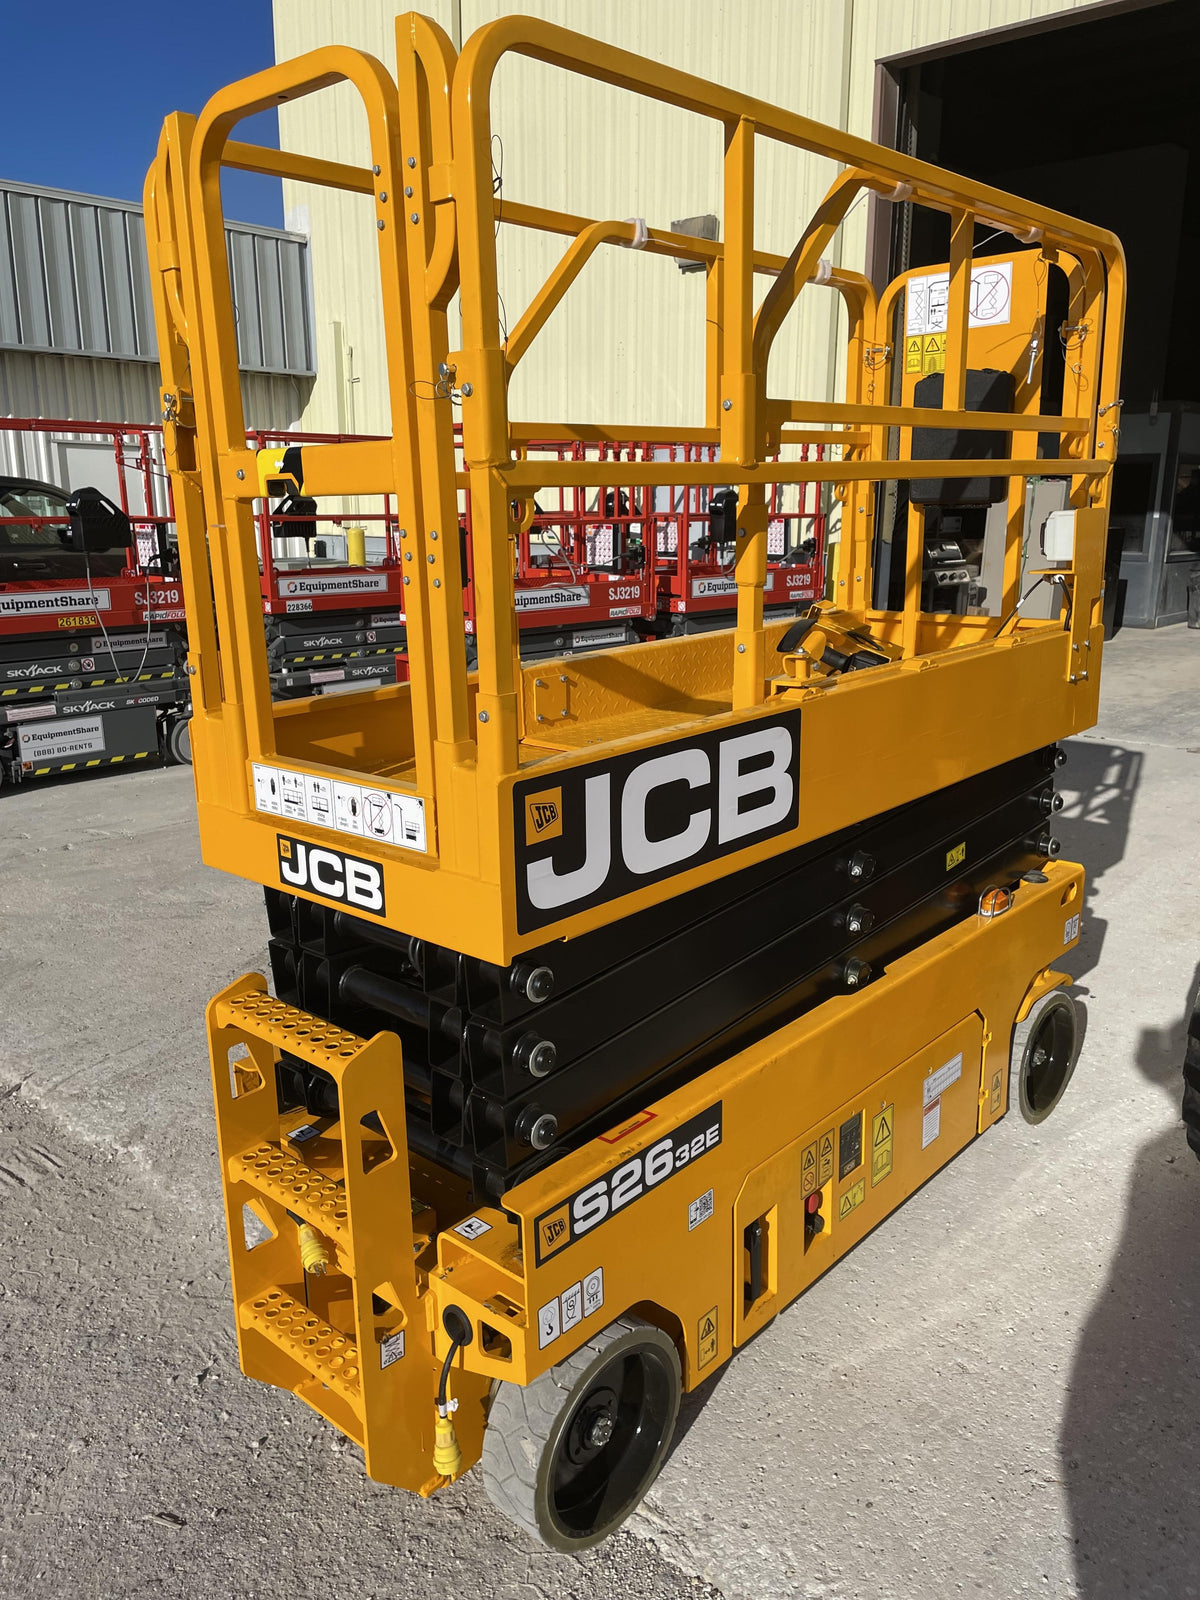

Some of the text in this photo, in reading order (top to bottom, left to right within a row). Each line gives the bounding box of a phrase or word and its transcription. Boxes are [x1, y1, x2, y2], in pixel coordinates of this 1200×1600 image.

[299, 579, 379, 592] EquipmentShare
[786, 574, 811, 587] SJ3219
[515, 592, 581, 607] uipmentShare
[609, 586, 640, 600] SJ3219
[0, 595, 99, 613] uipmentShare
[287, 601, 312, 612] 228366
[59, 616, 97, 627] 261839
[303, 636, 343, 647] SKYJACK
[7, 664, 63, 679] SKYJACK
[352, 666, 389, 676] SKYJACK
[63, 701, 116, 714] SKYJACK
[31, 726, 99, 741] EquipmentShare
[527, 727, 793, 909] JCB
[535, 805, 556, 829] JCB
[281, 843, 383, 910] JCB
[547, 1220, 565, 1241] JCB
